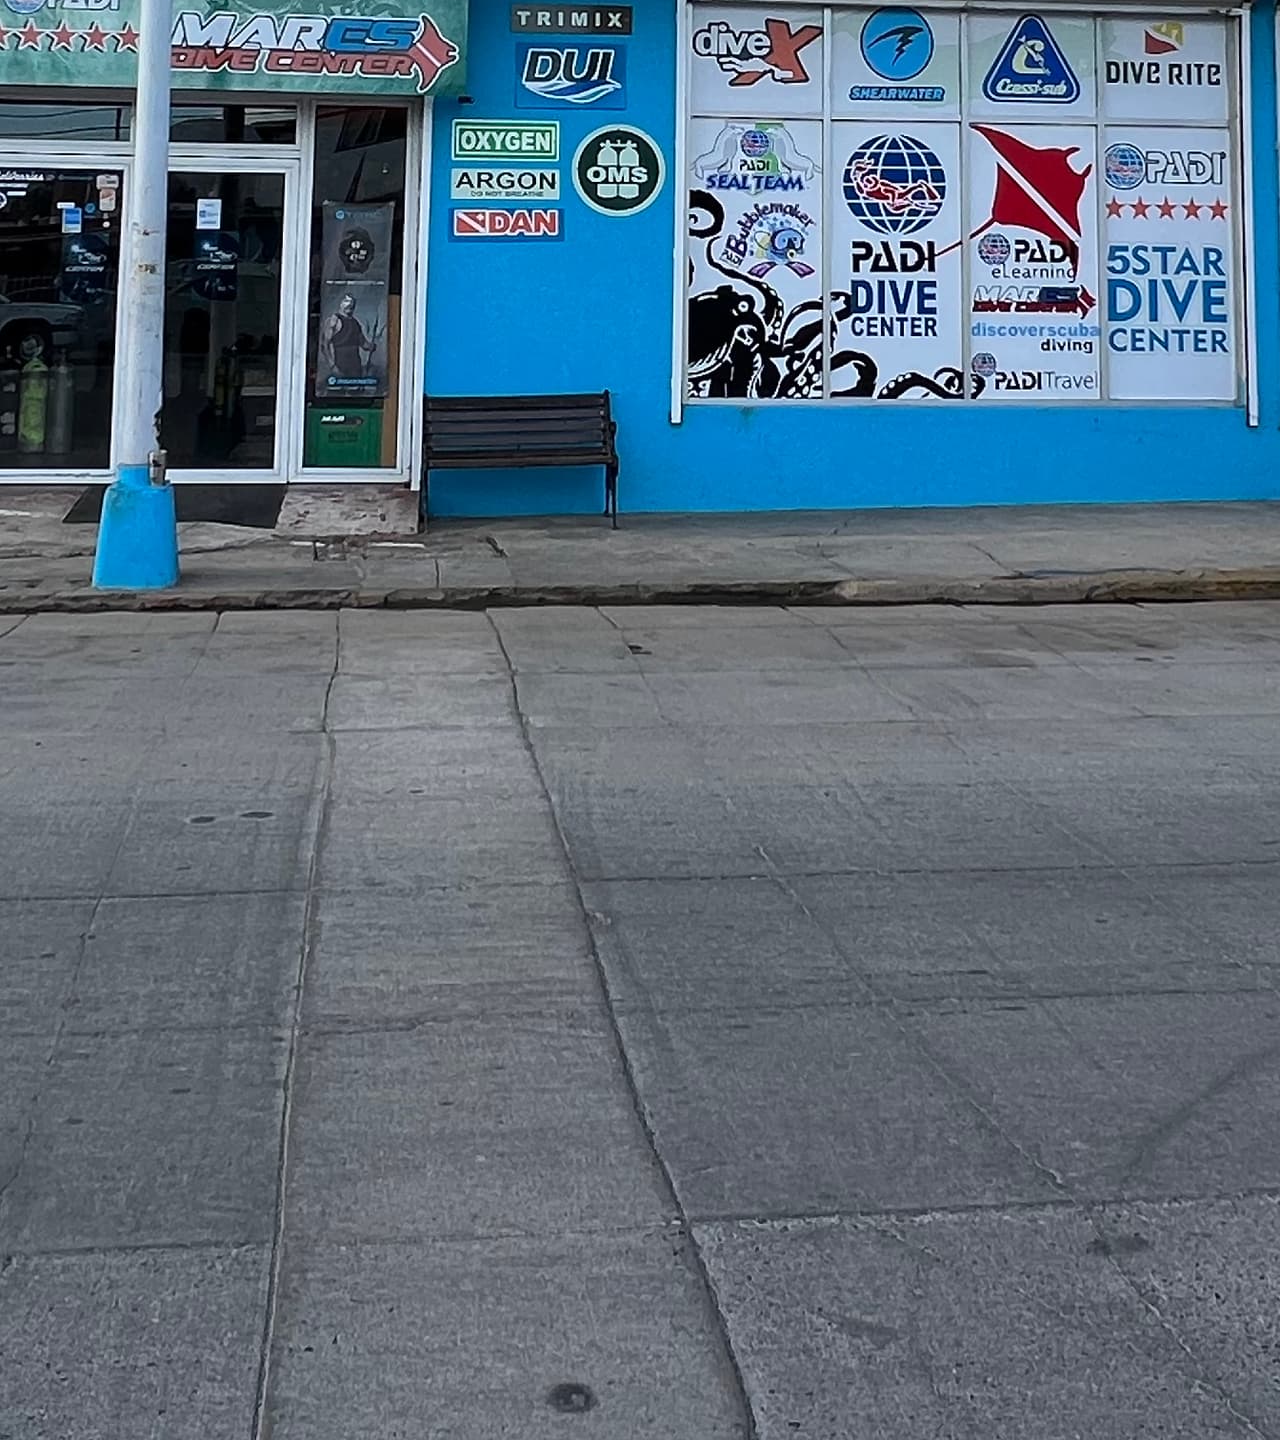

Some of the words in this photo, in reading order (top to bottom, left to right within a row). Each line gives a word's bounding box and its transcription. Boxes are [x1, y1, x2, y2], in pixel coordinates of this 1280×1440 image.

[516, 10, 623, 28] TRIMIX
[171, 12, 420, 52] MARES
[171, 46, 259, 72] DIVE
[268, 49, 416, 77] CENTER
[522, 48, 616, 84] DUI
[850, 86, 945, 101] SHEARWATER
[460, 130, 552, 151] OXYGEN
[586, 165, 649, 183] OMS
[739, 159, 770, 172] PADI
[1144, 151, 1225, 185] PADI
[456, 171, 556, 190] ARGON
[706, 174, 751, 190] SEAL
[753, 174, 804, 191] TEAM
[487, 210, 558, 235] DAN
[851, 240, 936, 273] PADI
[1107, 245, 1226, 276] 5STAR
[991, 263, 1076, 283] eLearning
[851, 279, 937, 315] DIVE
[1107, 279, 1228, 323] DIVE
[851, 316, 938, 337] CENTER
[1040, 339, 1094, 353] diving
[1108, 328, 1229, 353] CENTER
